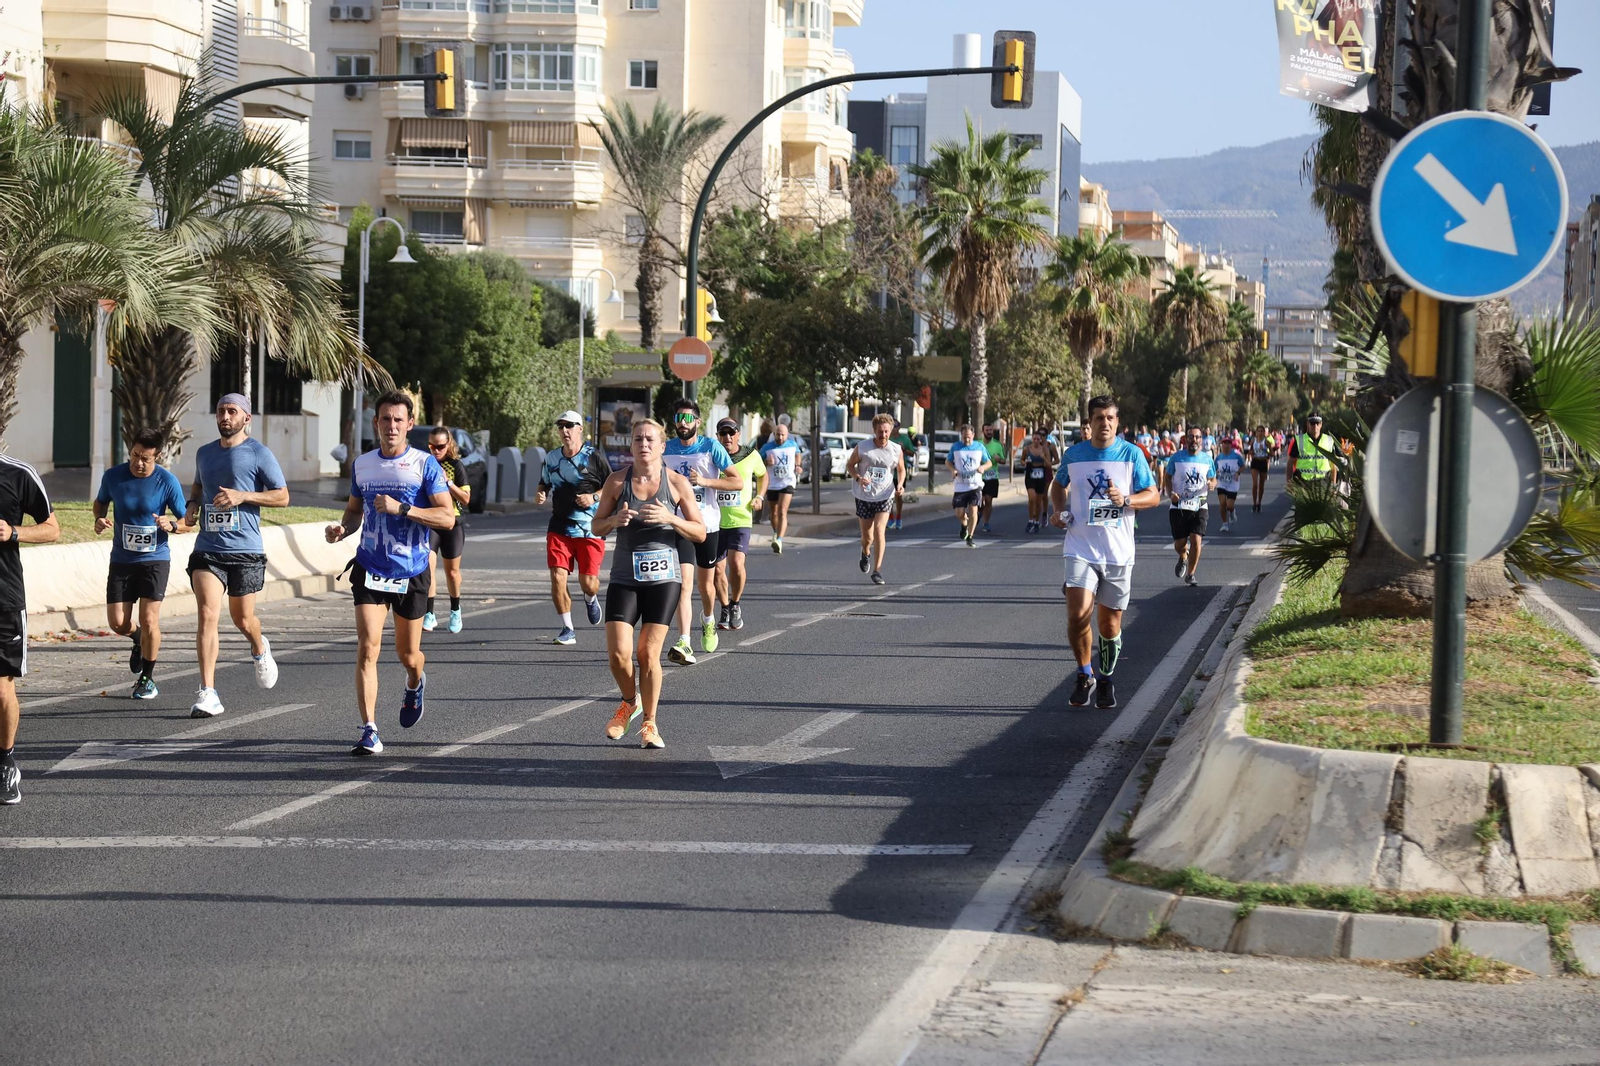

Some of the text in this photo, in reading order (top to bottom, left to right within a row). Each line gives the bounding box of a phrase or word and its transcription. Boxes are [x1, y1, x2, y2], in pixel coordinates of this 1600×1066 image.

[1293, 14, 1365, 46] PHA
[1299, 47, 1343, 65] MÁLAGA
[1342, 46, 1377, 74] EL
[1296, 56, 1344, 72] NOVIEMBRE
[1290, 63, 1358, 83] PALACIO DE DEPORTES
[361, 482, 370, 491] 31
[718, 492, 737, 501] 607
[209, 513, 232, 523] 367
[1094, 508, 1119, 519] 278
[127, 533, 152, 544] 729
[640, 560, 668, 572] 623
